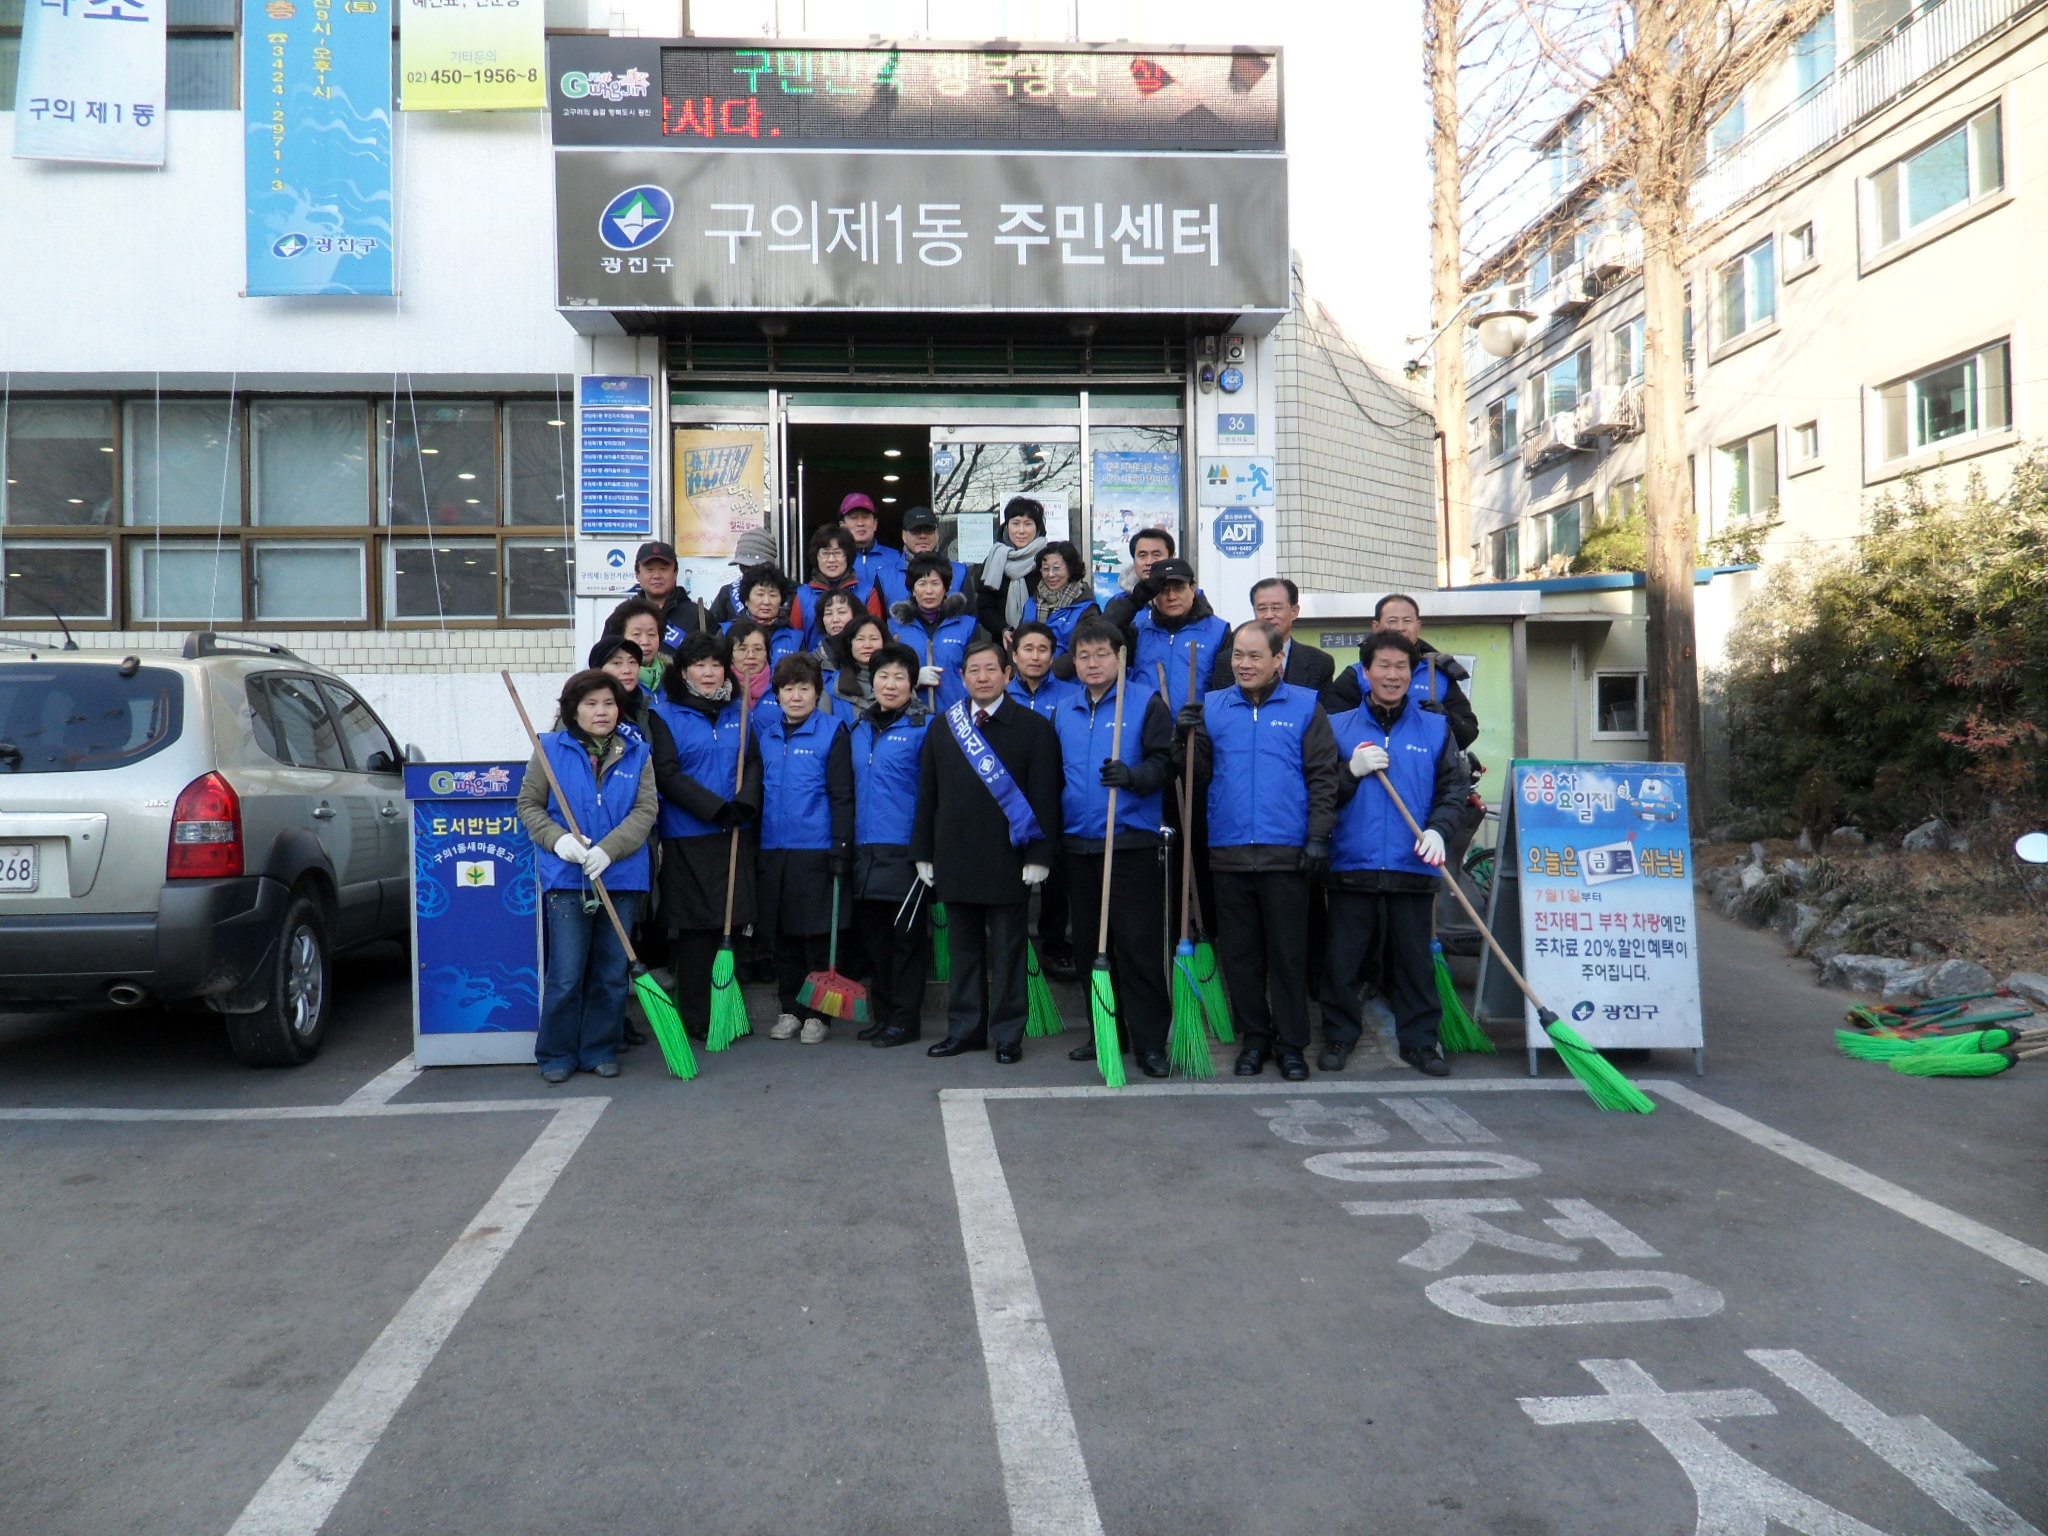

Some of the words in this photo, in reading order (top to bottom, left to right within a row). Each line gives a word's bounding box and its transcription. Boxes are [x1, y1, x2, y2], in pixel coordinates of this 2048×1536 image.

[406, 71, 428, 85] 02)
[430, 67, 538, 85] 450-1956~8
[703, 200, 969, 267] 구의제1동
[993, 202, 1220, 267] 주민센터
[313, 237, 378, 254] 광진구
[600, 256, 676, 275] 광진구
[1228, 416, 1245, 431] 36
[1221, 523, 1256, 542] ADT
[1523, 773, 1578, 804] 승용차
[1558, 792, 1616, 824] 요일제
[432, 816, 518, 836] 도서반납기
[1527, 846, 1580, 877] 오늘은
[1599, 912, 1629, 933] 부착
[1632, 912, 1687, 934] 차량에만
[1534, 937, 1580, 959] 주차료
[1581, 963, 1651, 982] 주어집니다.
[1602, 1004, 1660, 1020] 광진구
